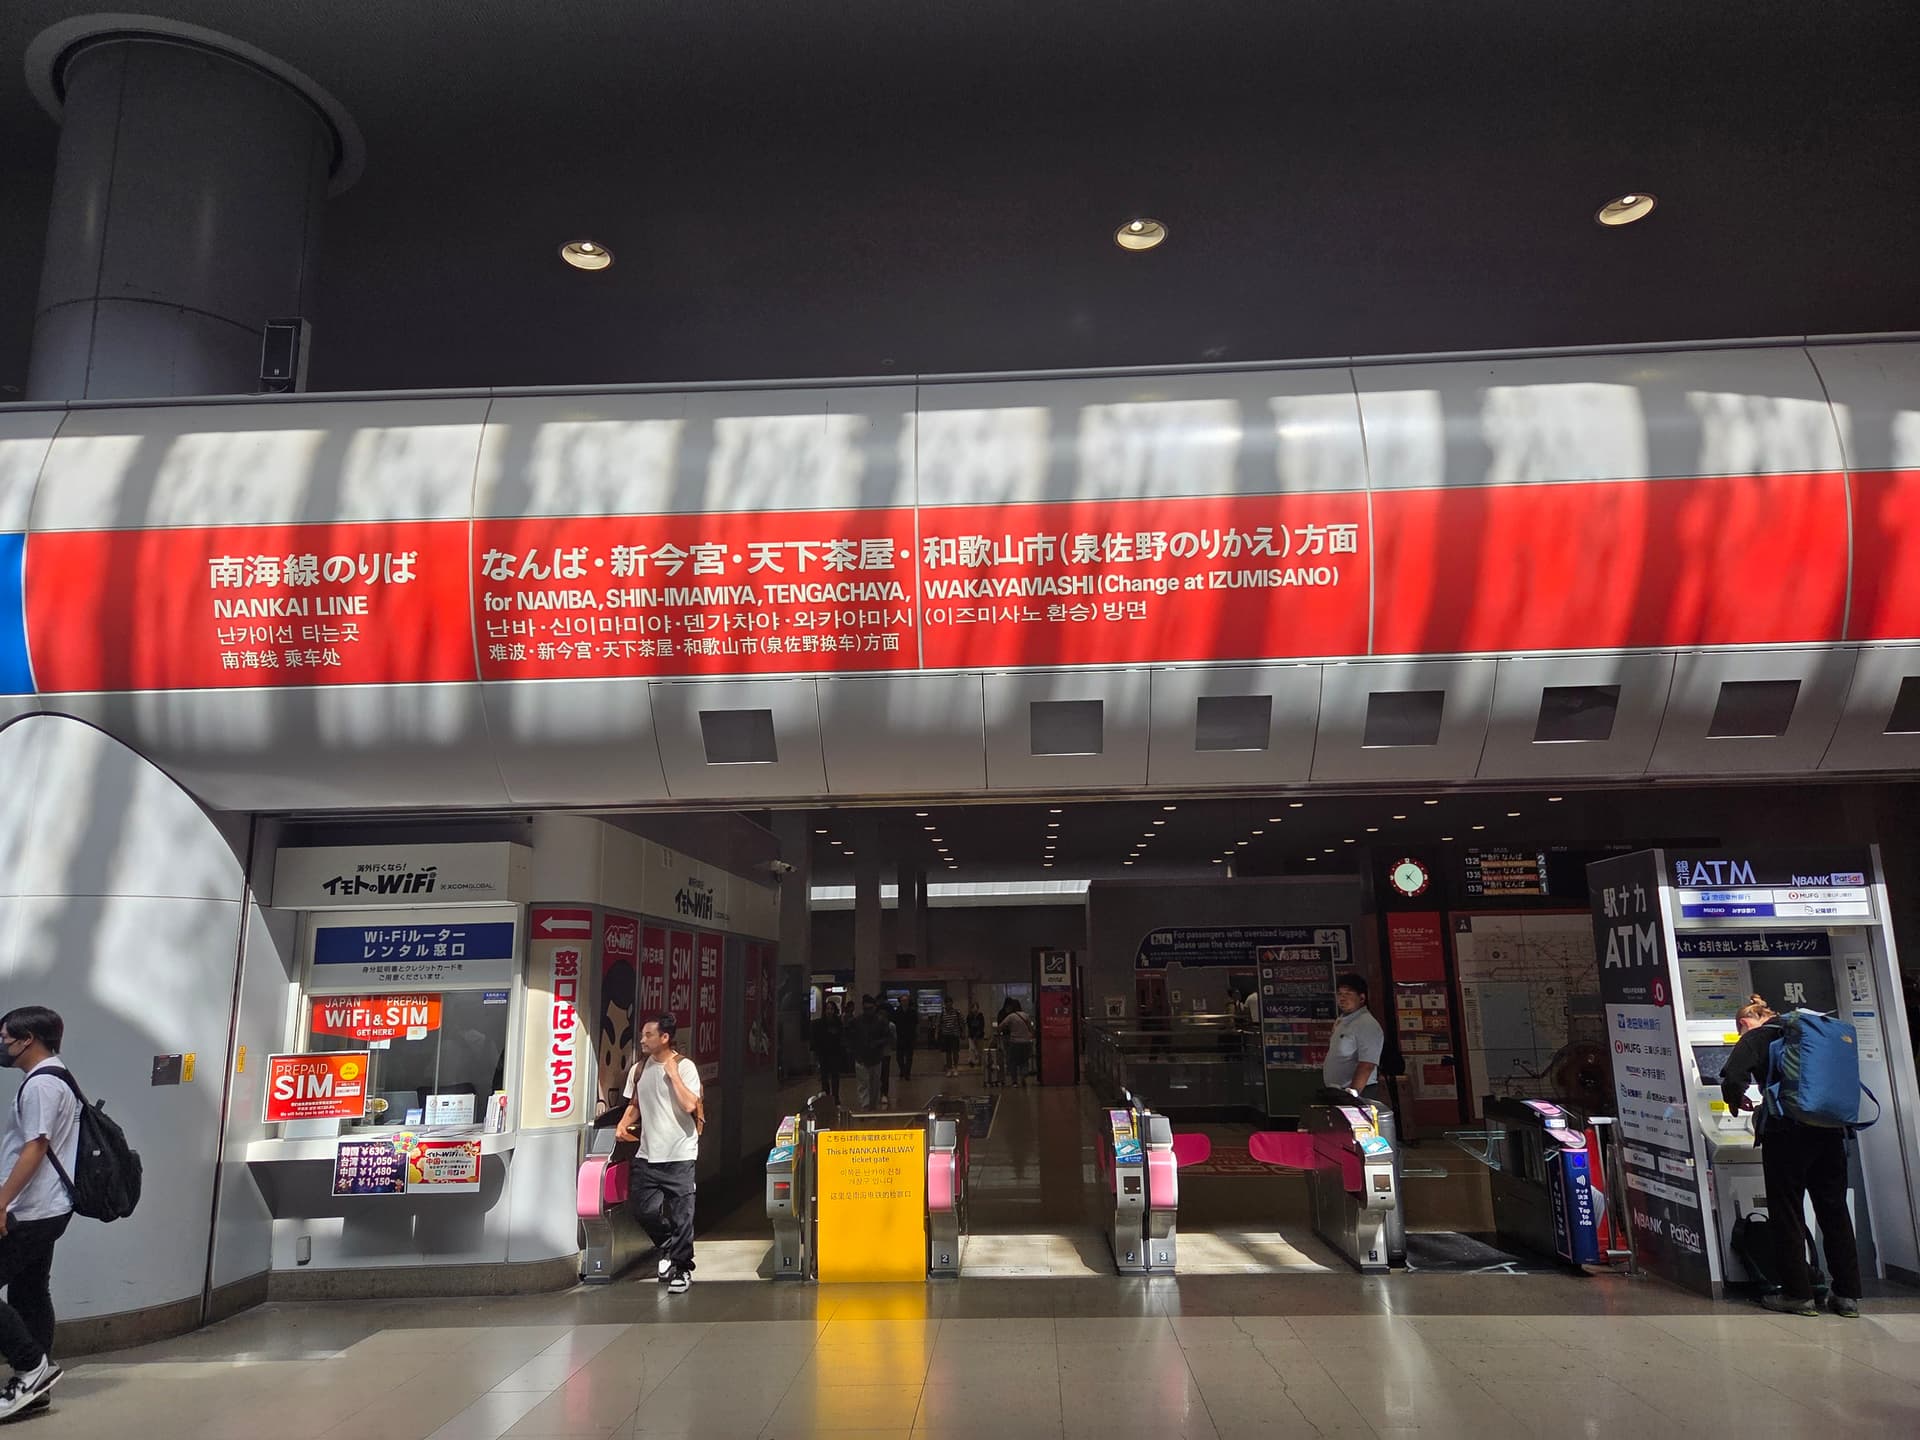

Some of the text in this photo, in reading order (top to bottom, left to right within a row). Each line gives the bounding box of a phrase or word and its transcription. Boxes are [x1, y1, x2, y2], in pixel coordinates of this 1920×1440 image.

[208, 551, 418, 589] 南海線のりば
[484, 594, 513, 613] for
[517, 590, 603, 611] NAMBA,
[606, 585, 763, 608] SHIN-IMAMIYA,
[764, 581, 911, 604] TENGACHAYA,
[925, 575, 1094, 599] WAKAYAMASHI
[1184, 573, 1204, 590] at
[1208, 566, 1339, 589] IZUMISANO)
[214, 596, 369, 619] NANKAI LINE
[1047, 605, 1098, 624] 환승)
[1103, 602, 1147, 622] 방면
[217, 622, 360, 646] 난카이선 타는곳
[220, 650, 280, 670] 南海线
[1537, 855, 1547, 865] 2
[1539, 868, 1548, 879] 2
[1675, 860, 1690, 886] 銀行
[1690, 860, 1757, 886] ATM
[1791, 874, 1831, 887] NBANK
[1540, 882, 1548, 894] 1
[364, 928, 466, 943] Wi-Fiルーター
[1604, 920, 1660, 969] ATM
[363, 943, 465, 959] レンタル窓口
[672, 946, 691, 980] SIM
[325, 995, 428, 1008] JAPAN PREPAID
[671, 984, 690, 1011] eSIM
[1784, 982, 1807, 1004] 駅
[325, 1006, 428, 1027] WiFi & SIM
[356, 1027, 396, 1037] GET HERE!
[550, 951, 578, 1113] 窓口はこちら
[699, 1021, 716, 1053] OK!
[276, 1063, 328, 1075] PREPAID
[274, 1073, 333, 1100] SIM
[849, 1147, 879, 1155] NANKAI
[873, 1156, 889, 1164] gate
[340, 1167, 358, 1177] 中国
